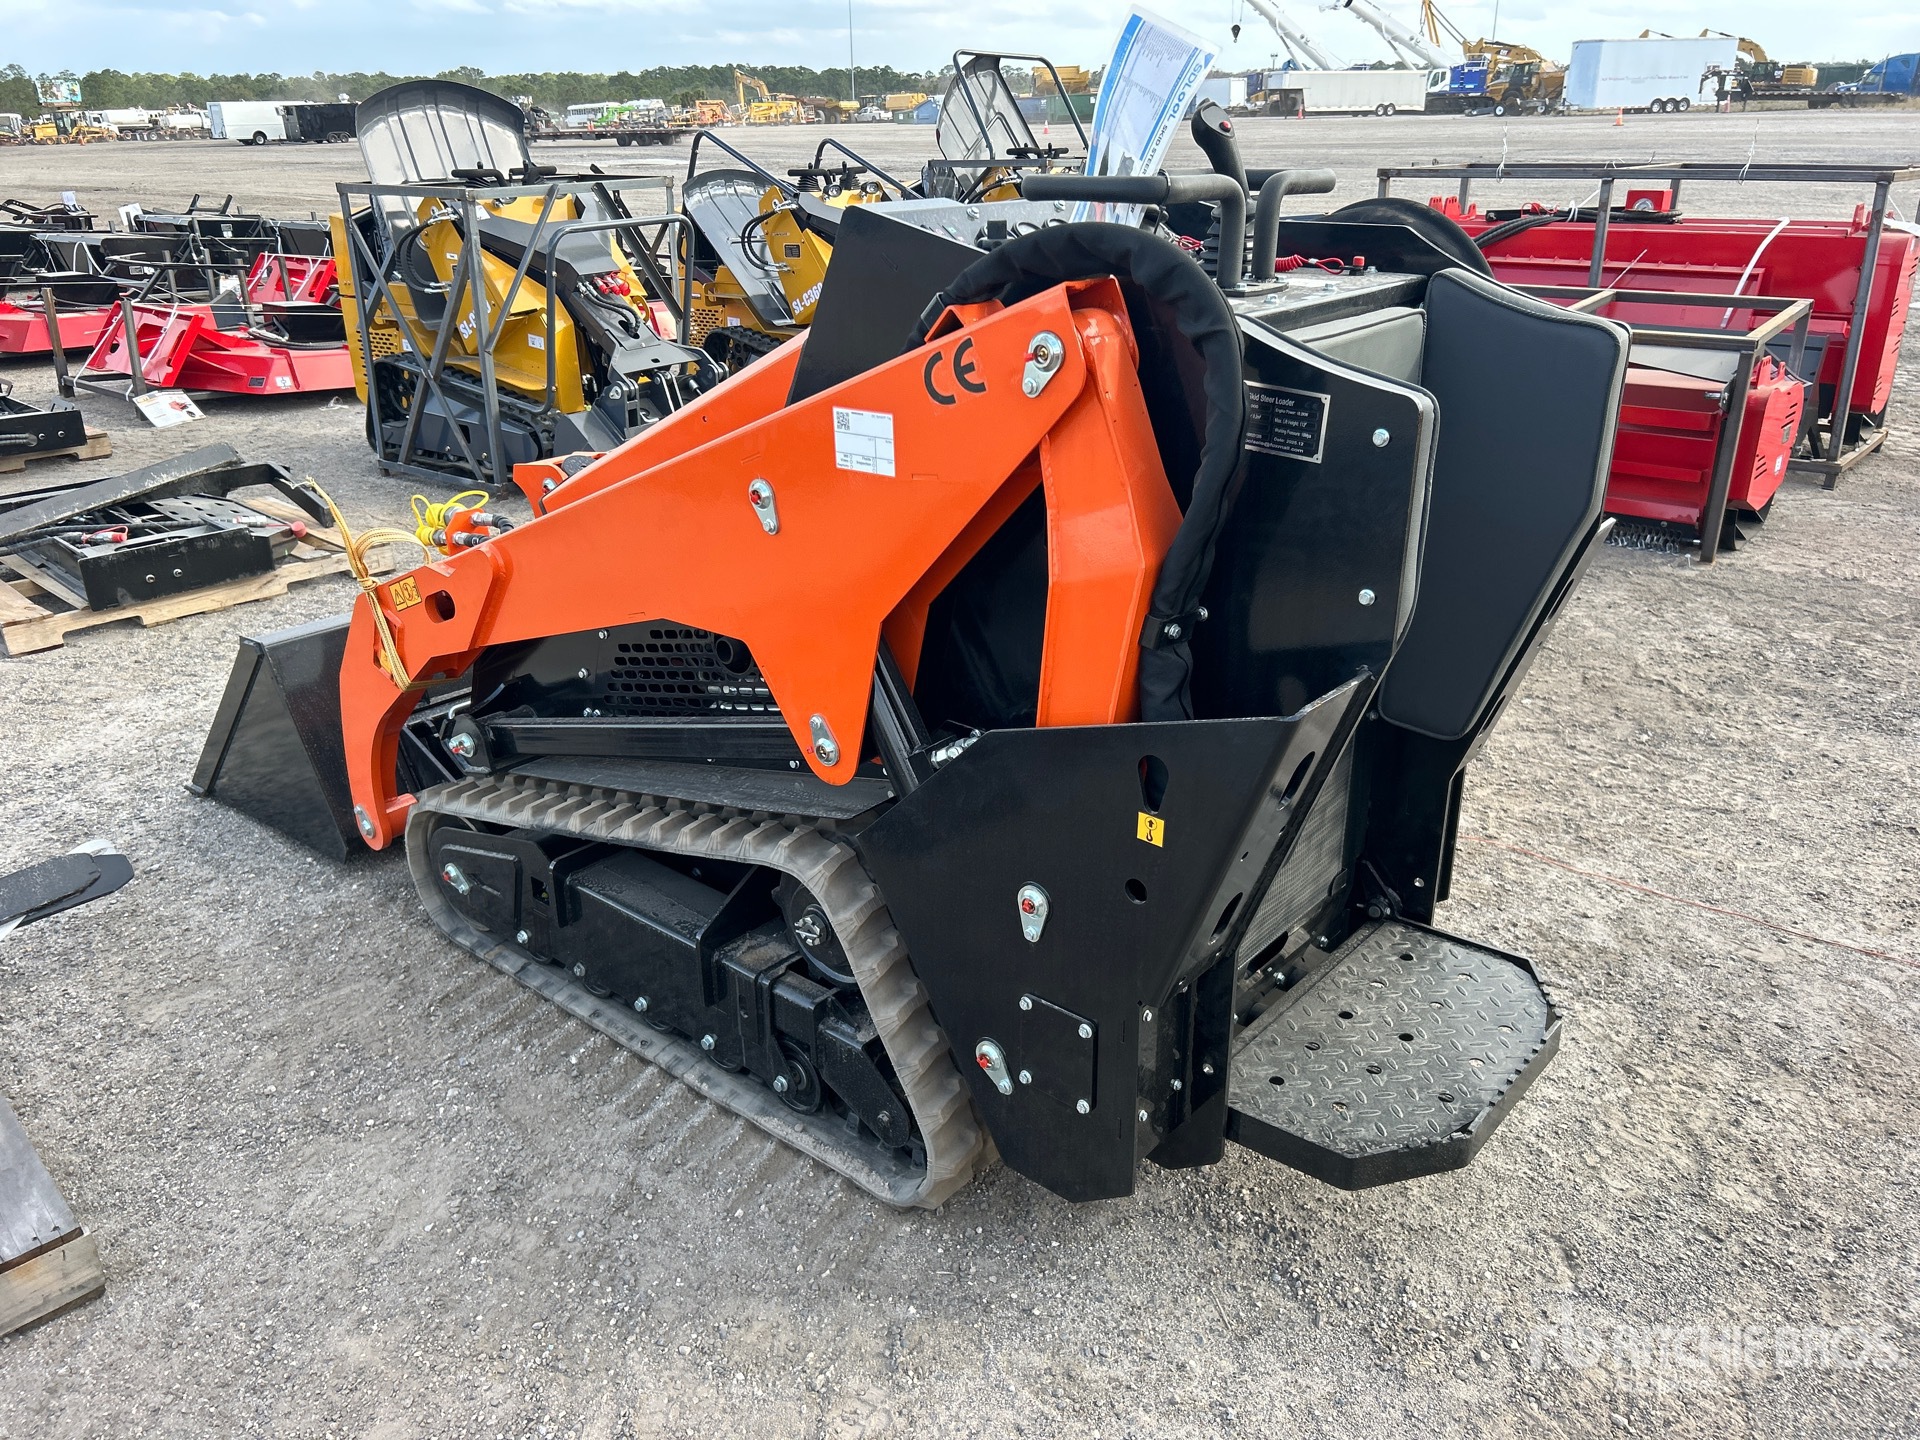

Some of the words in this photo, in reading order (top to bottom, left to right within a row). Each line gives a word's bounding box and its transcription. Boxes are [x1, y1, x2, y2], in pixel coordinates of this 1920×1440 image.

[1166, 62, 1203, 123] SDLOOL
[1155, 123, 1169, 147] SKID
[1141, 146, 1158, 176] STEER
[1260, 394, 1275, 404] Steer
[1275, 397, 1295, 407] Loader
